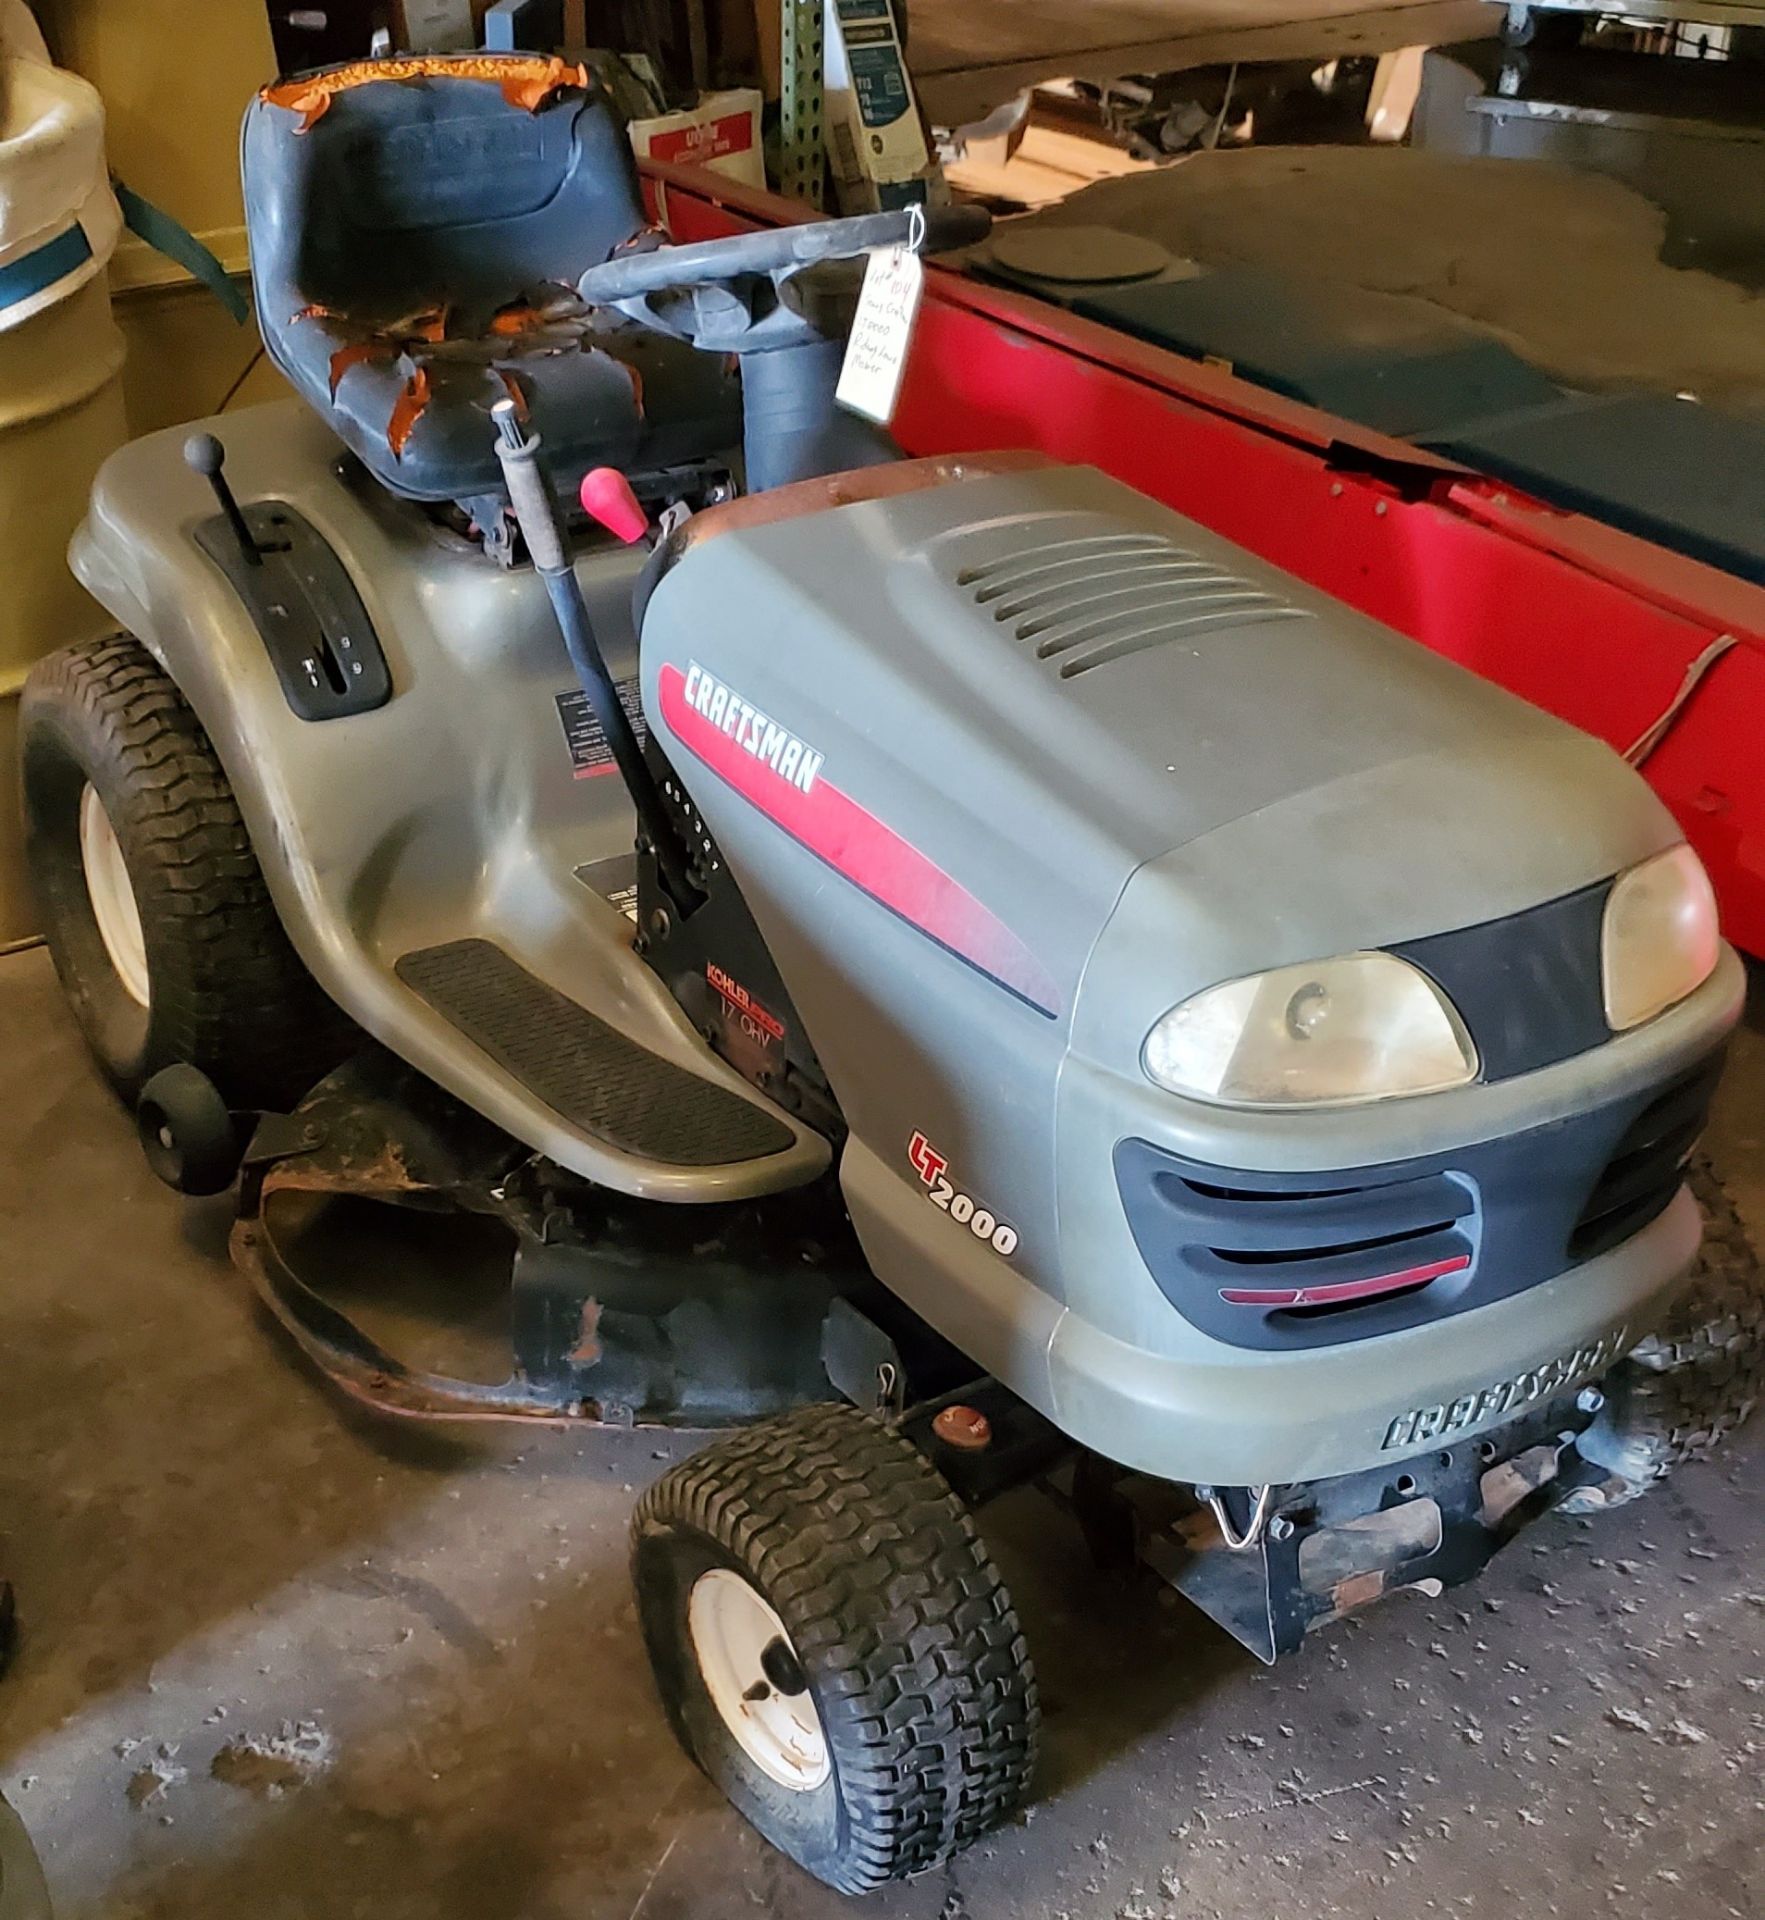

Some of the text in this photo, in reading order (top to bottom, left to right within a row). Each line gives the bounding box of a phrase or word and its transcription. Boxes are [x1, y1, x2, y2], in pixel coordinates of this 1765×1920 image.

[684, 665, 822, 794] CRAFTSMAN
[707, 959, 751, 1009] KOHLER
[740, 1013, 771, 1048] OHV
